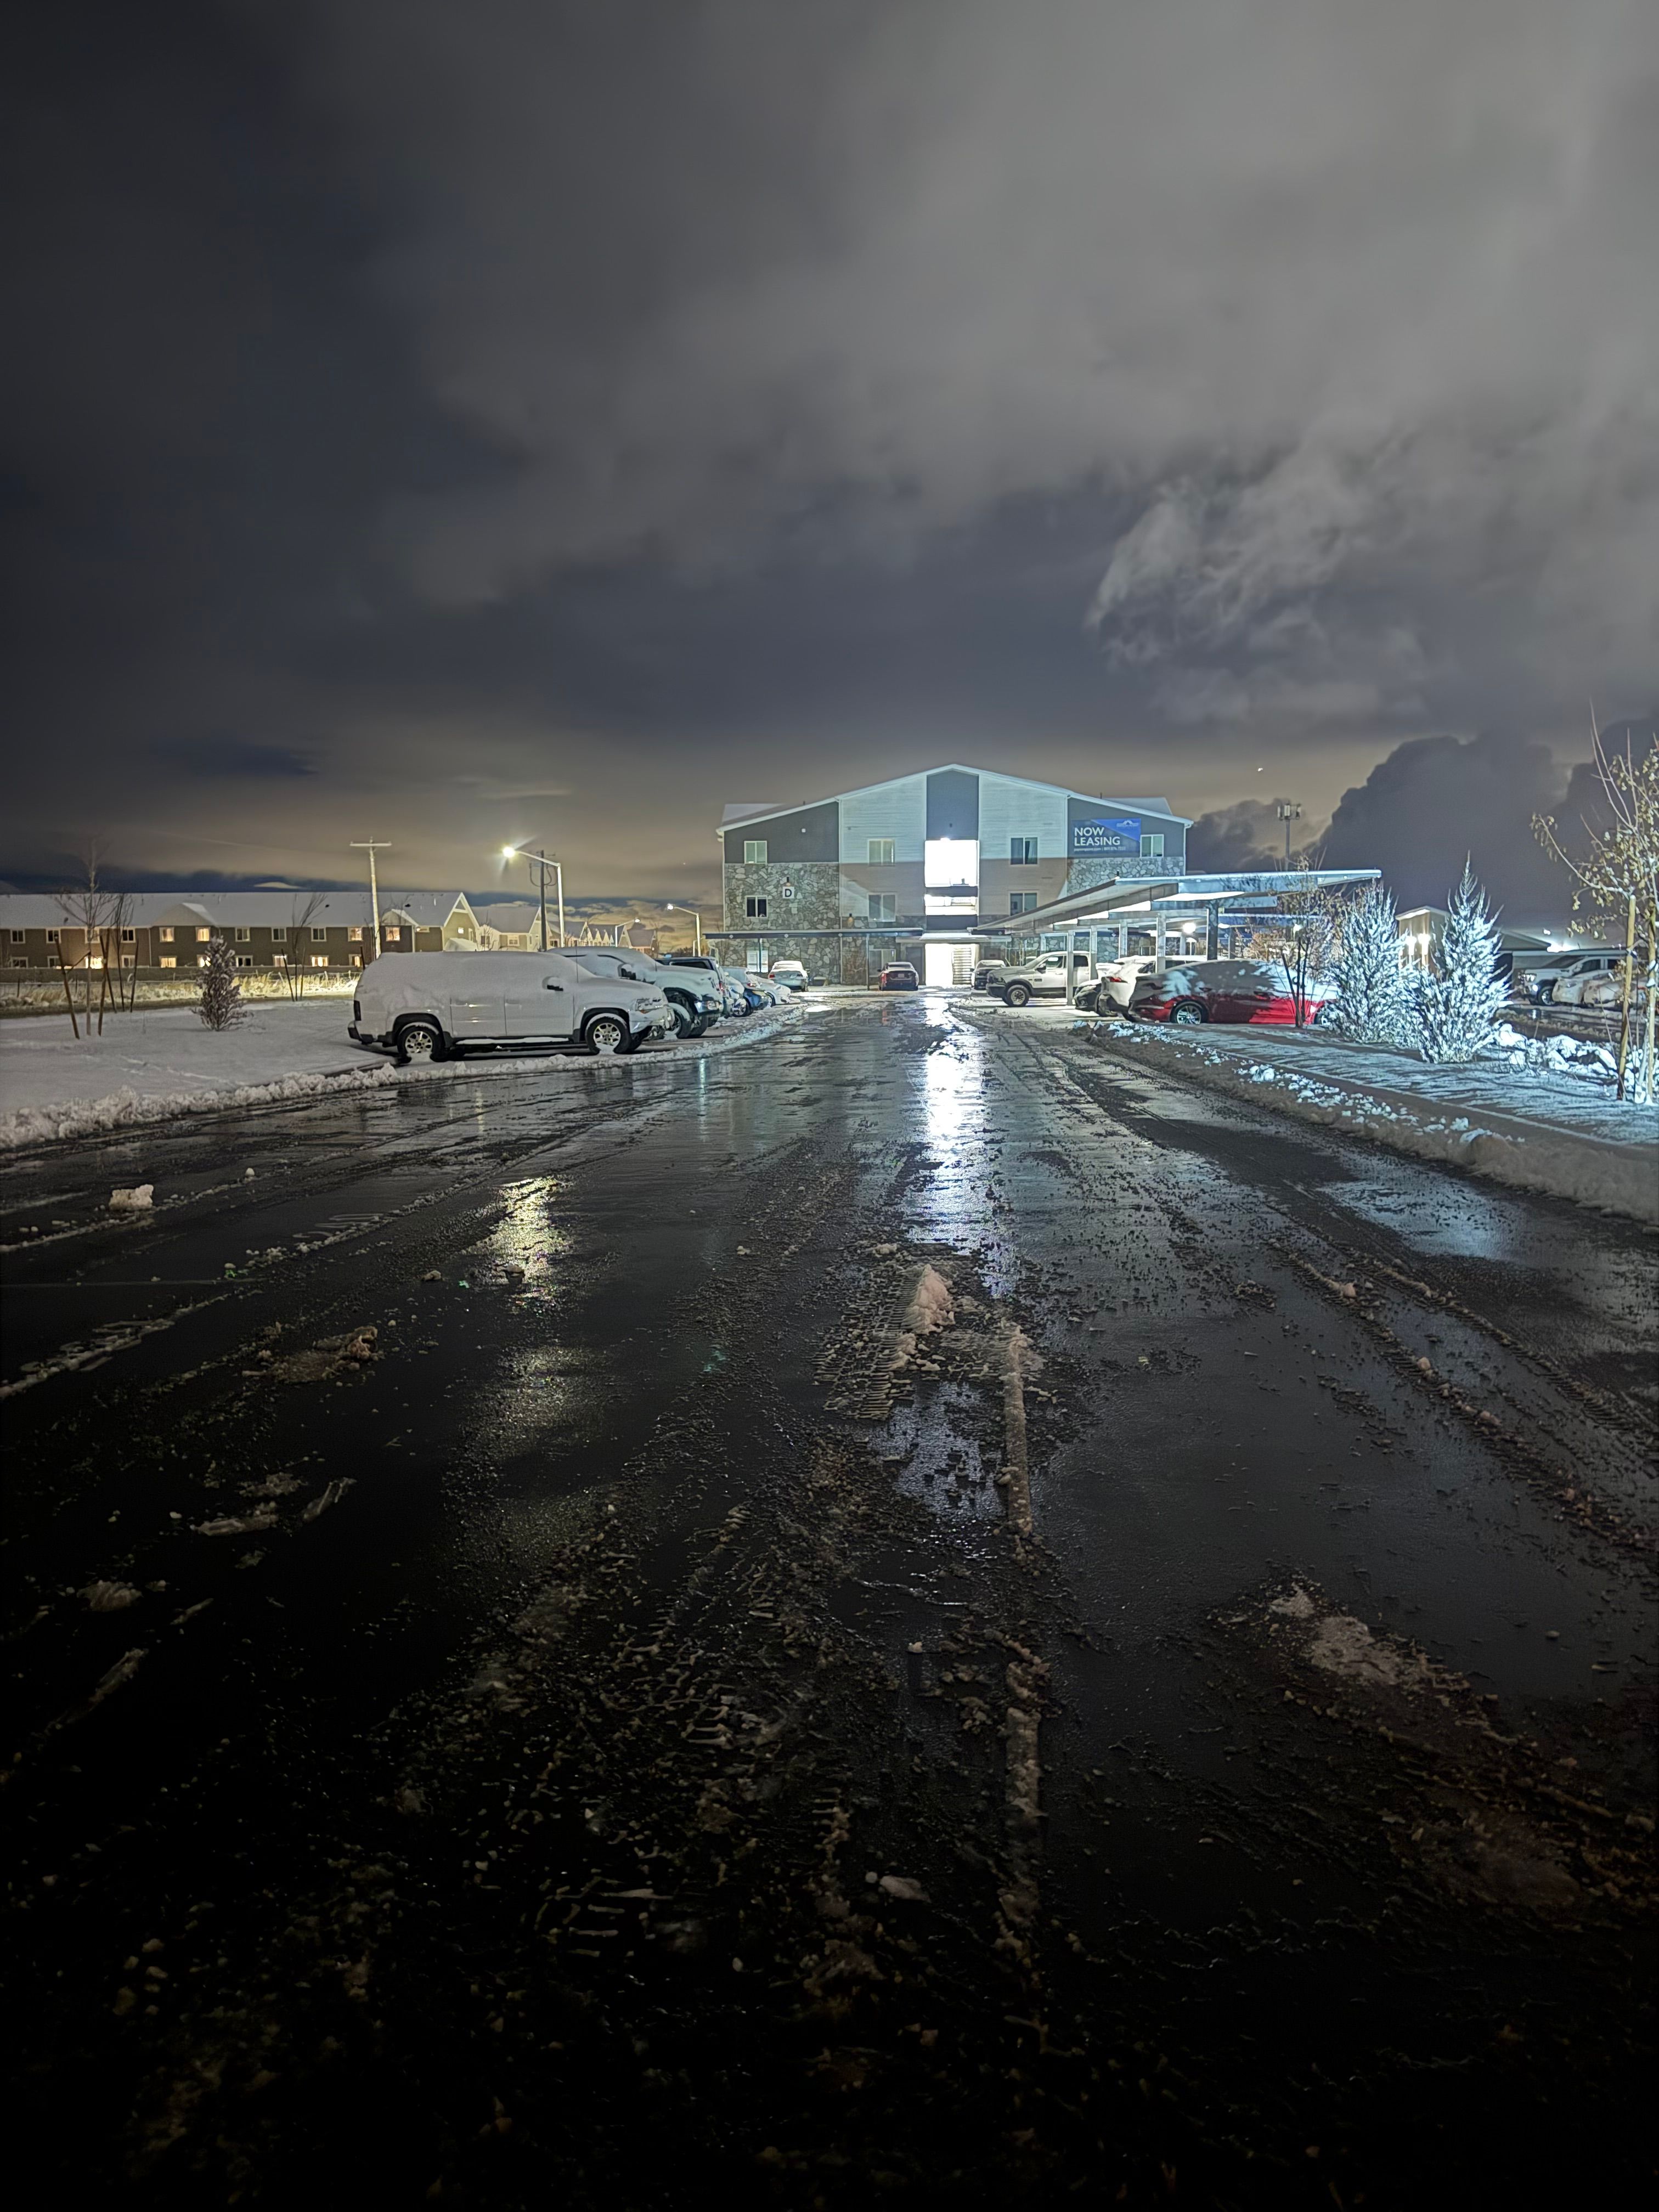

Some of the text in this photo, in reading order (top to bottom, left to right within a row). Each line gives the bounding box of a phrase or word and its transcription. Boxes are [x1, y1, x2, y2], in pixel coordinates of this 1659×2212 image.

[1074, 827, 1104, 836] NOW
[1074, 836, 1120, 846] LEASING
[785, 889, 792, 897] D
